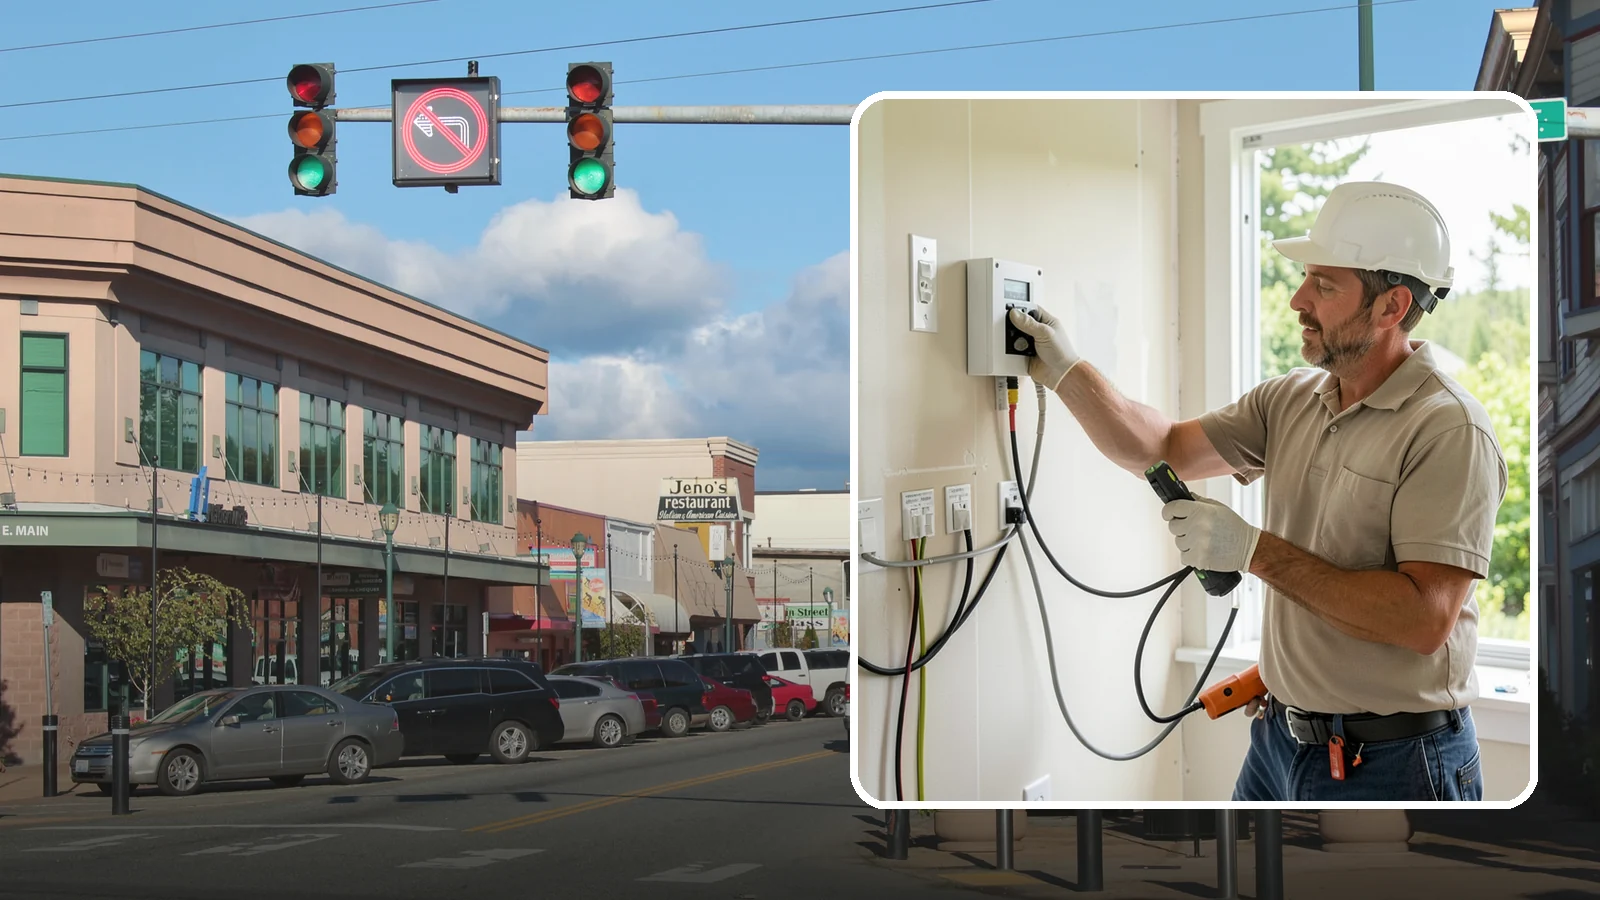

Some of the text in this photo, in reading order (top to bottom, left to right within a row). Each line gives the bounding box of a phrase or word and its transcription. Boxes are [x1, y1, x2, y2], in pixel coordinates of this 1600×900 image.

[669, 480, 727, 494] Jeno's
[665, 496, 731, 509] restaurant
[659, 510, 681, 519] Italian
[686, 510, 714, 519] American
[715, 510, 738, 519] Cuisine
[2, 525, 49, 536] E. MAIN
[797, 608, 828, 617] Street
